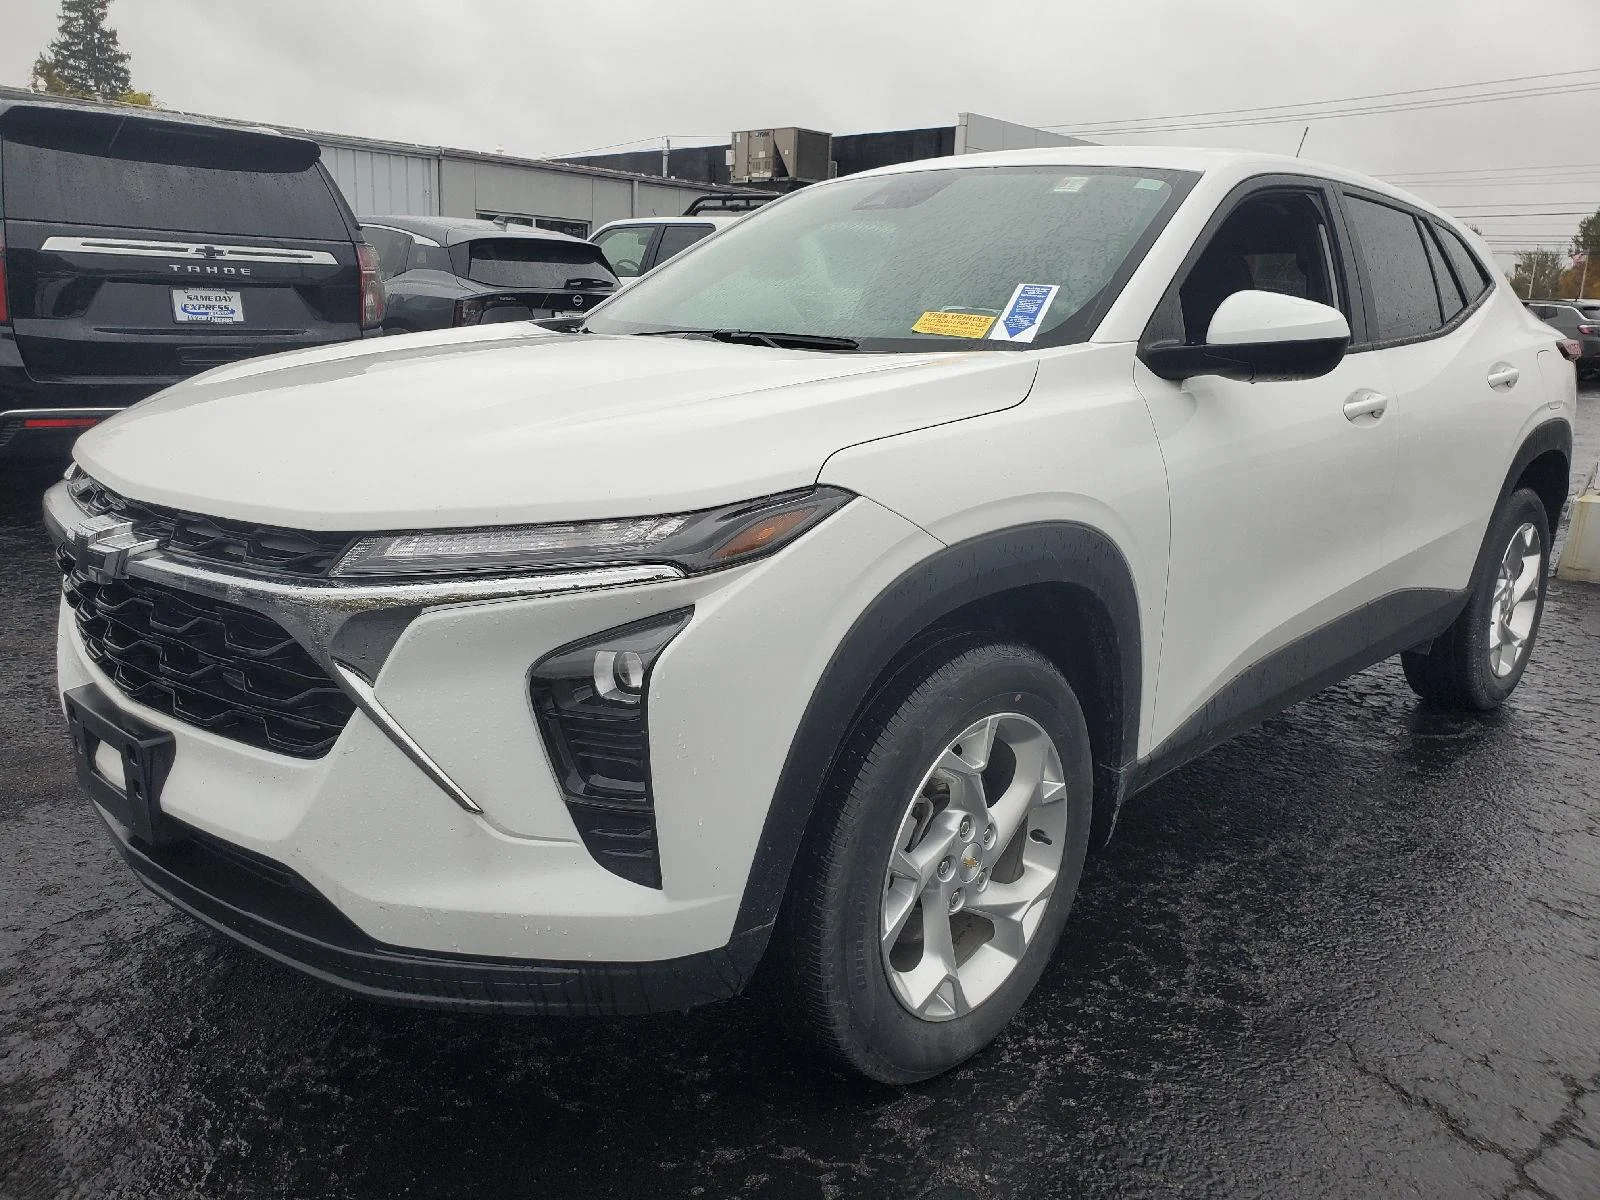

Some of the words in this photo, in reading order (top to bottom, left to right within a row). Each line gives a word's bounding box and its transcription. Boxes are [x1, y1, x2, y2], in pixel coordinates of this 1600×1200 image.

[168, 264, 251, 275] TAHOE
[186, 294, 213, 302] SAME
[183, 303, 230, 311] EXPRESS
[951, 313, 991, 324] VEHICLE
